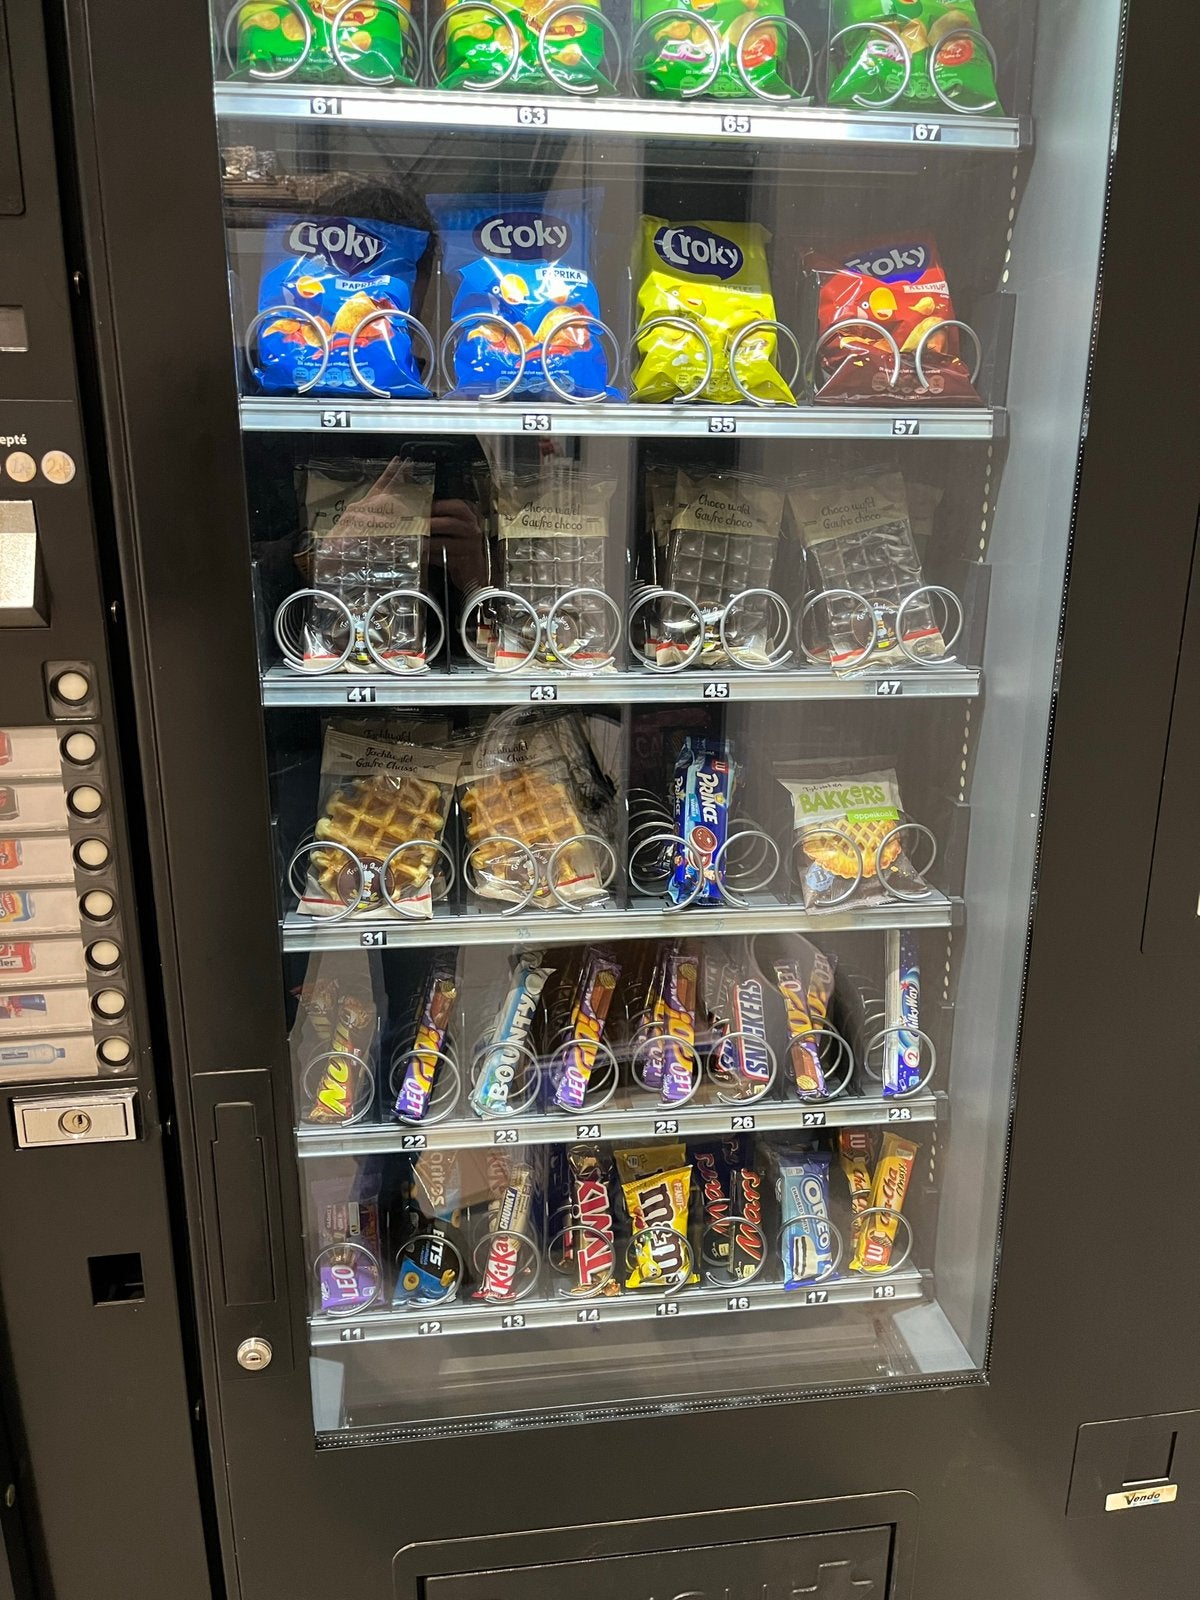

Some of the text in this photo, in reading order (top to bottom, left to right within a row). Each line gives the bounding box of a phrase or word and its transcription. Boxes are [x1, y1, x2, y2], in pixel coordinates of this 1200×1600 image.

[312, 98, 338, 114] 61
[519, 108, 545, 124] 63
[723, 117, 749, 132] 65
[915, 124, 939, 140] 67
[289, 221, 381, 264] Croky
[481, 218, 568, 254] Croky
[661, 228, 739, 269] Croky
[323, 412, 348, 426] 51
[524, 416, 549, 430] 53
[710, 418, 735, 432] 55
[894, 420, 918, 434] 57
[531, 686, 556, 700] 43
[704, 684, 729, 697] 45
[877, 681, 901, 694] 47
[348, 688, 372, 702] 41
[696, 771, 719, 825] PRINCE
[362, 931, 384, 945] 31
[742, 979, 770, 1076] SNICKERS
[488, 993, 537, 1106] BOUNTY
[568, 1065, 586, 1103] LEO
[670, 1061, 692, 1095] LEO
[406, 1077, 425, 1115] LEO
[803, 1112, 825, 1125] 27
[889, 1108, 911, 1120] 28
[655, 1121, 678, 1133] 25
[732, 1116, 754, 1129] 26
[495, 1130, 518, 1143] 23
[578, 1125, 600, 1138] 24
[404, 1136, 426, 1148] 22
[850, 1134, 866, 1149] LU
[430, 1152, 446, 1207] oritos
[674, 1180, 684, 1207] PEANUT
[695, 1152, 731, 1238] Mars
[499, 1190, 516, 1230] CHUNKY
[735, 1167, 762, 1262] Mars
[804, 1180, 831, 1248] OREO
[572, 1180, 615, 1286] TWIX
[866, 1244, 884, 1261] LU
[332, 1265, 359, 1298] LEO
[807, 1291, 827, 1304] 17
[874, 1286, 894, 1298] 18
[657, 1303, 678, 1315] 15
[729, 1298, 749, 1309] 16
[504, 1315, 525, 1327] 13
[579, 1309, 599, 1321] 14
[342, 1328, 362, 1340] 11
[420, 1322, 441, 1334] 12
[1124, 1492, 1161, 1505] Vendo
